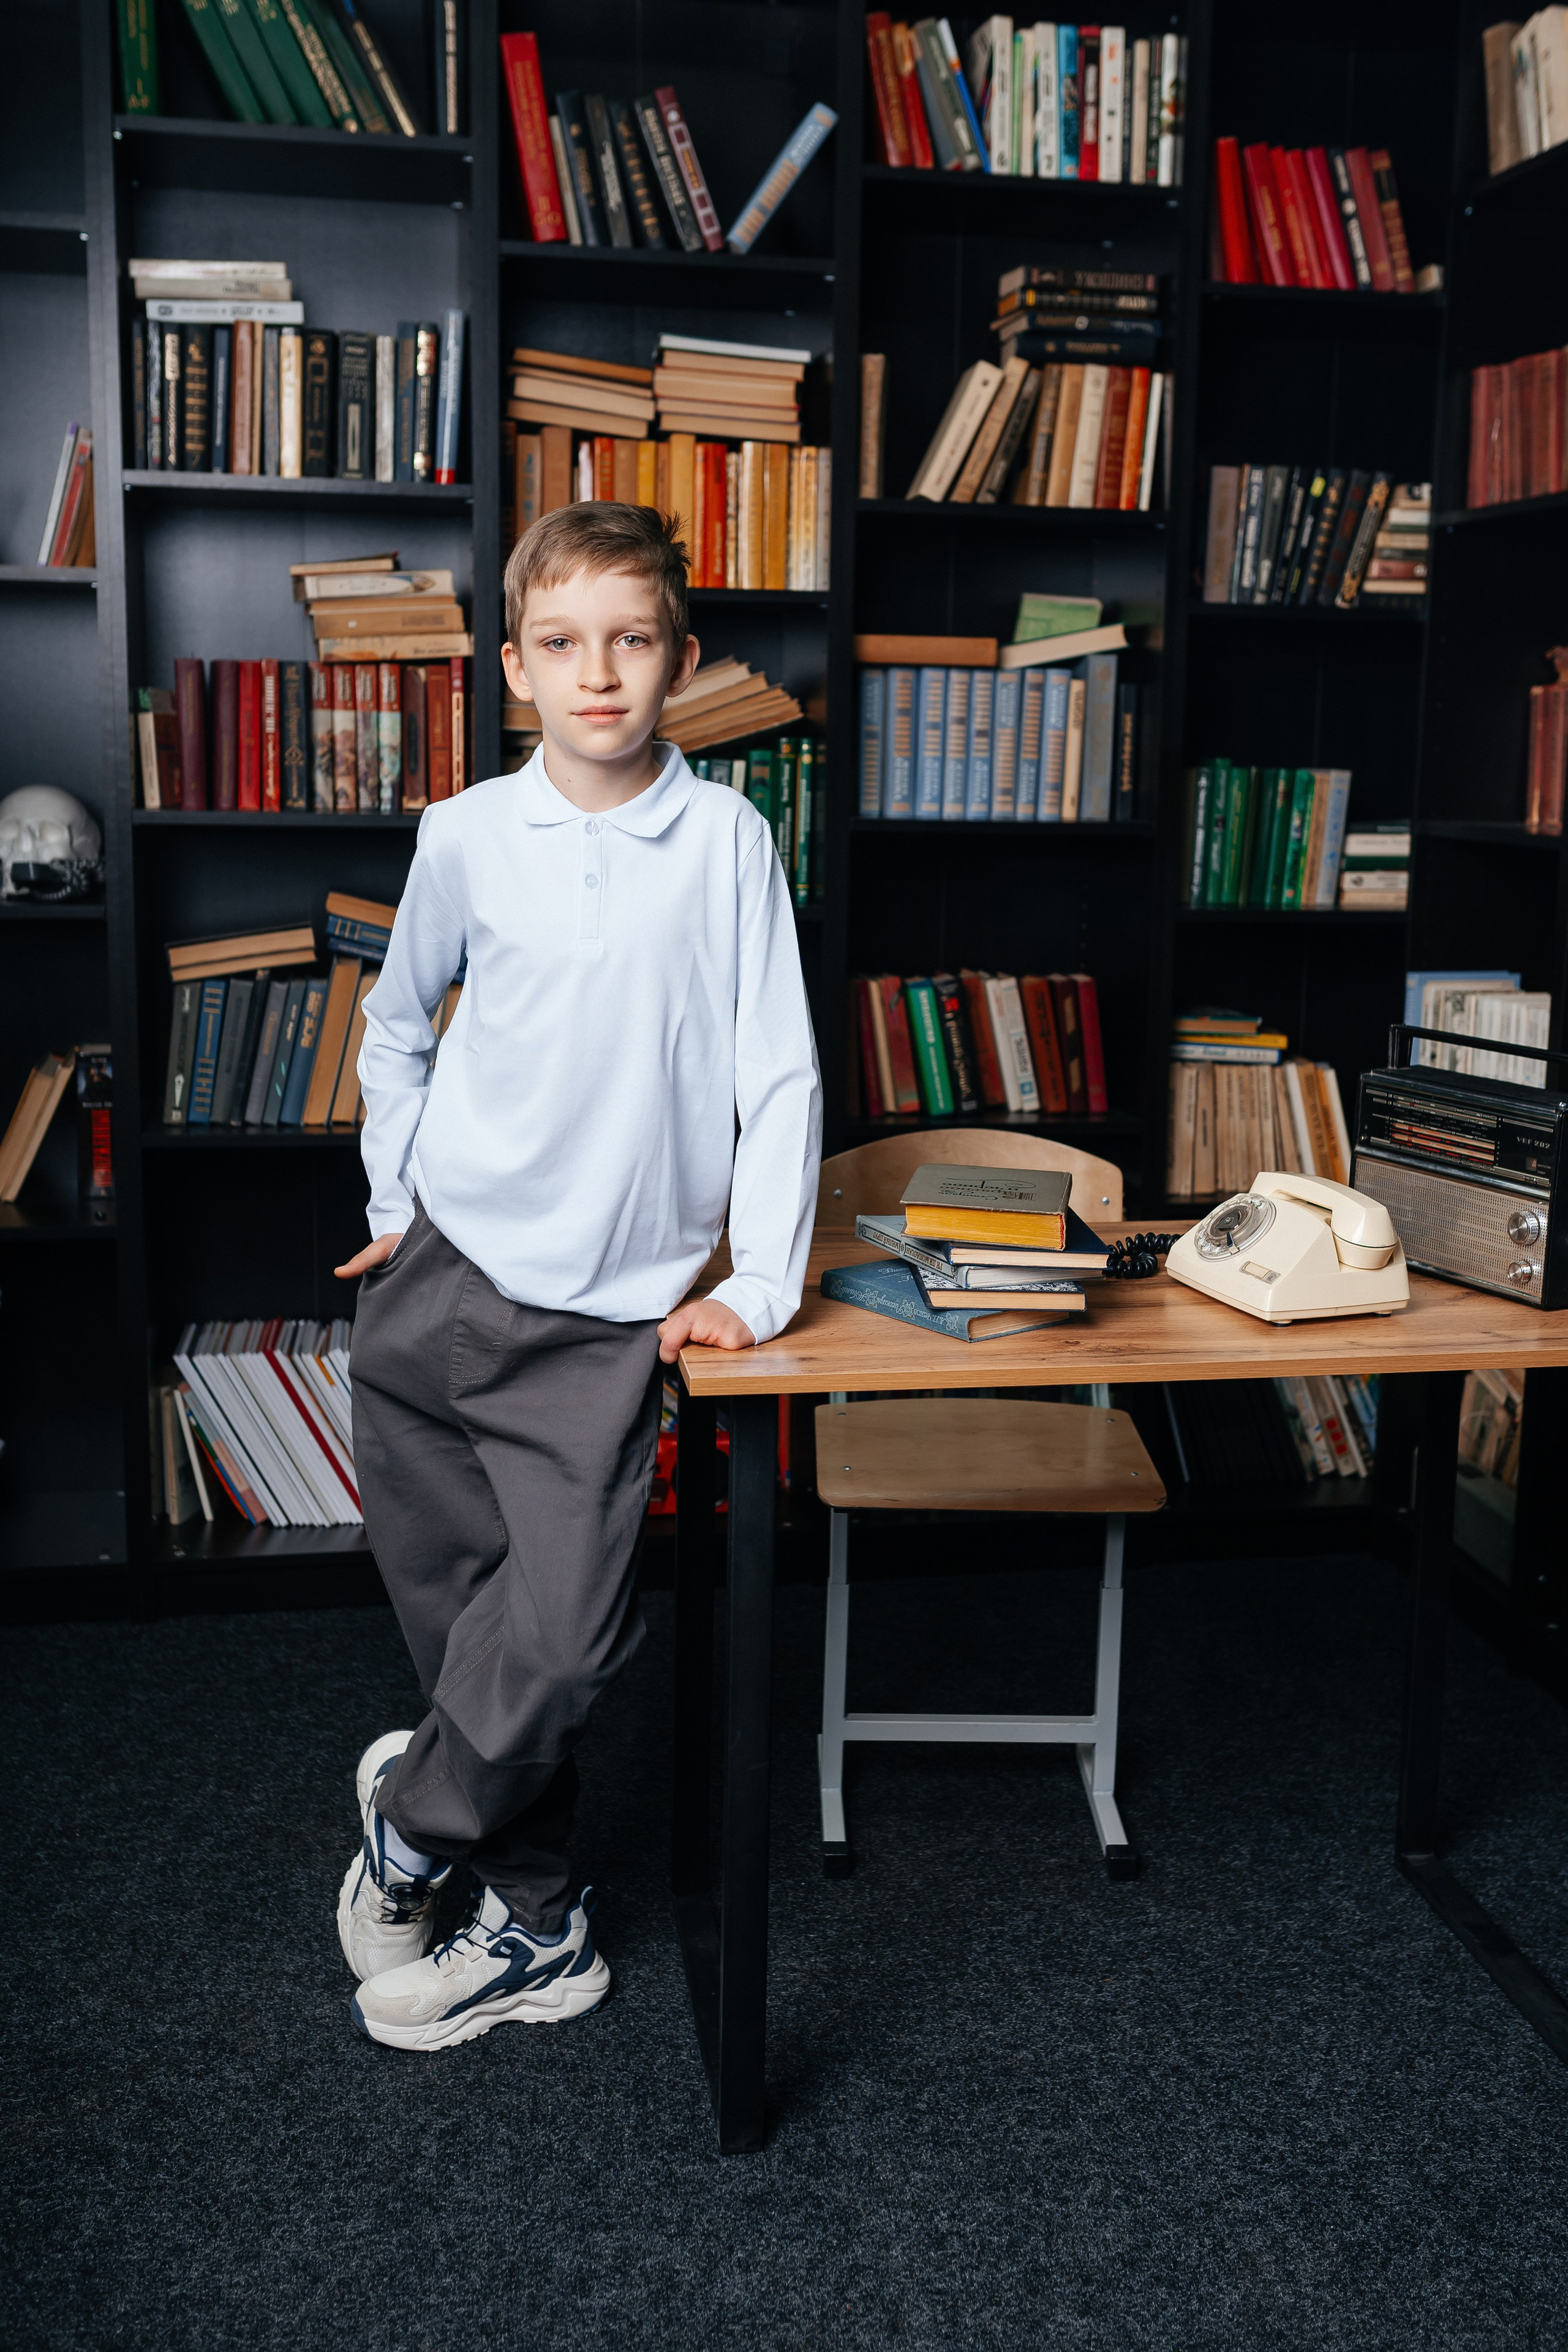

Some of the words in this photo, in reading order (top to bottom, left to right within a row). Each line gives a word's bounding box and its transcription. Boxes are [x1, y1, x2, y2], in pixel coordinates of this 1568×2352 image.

[1517, 1136, 1532, 1145] VEF
[1534, 1140, 1550, 1149] 202
[872, 1232, 884, 1242] ДРУГ
[883, 1236, 900, 1249] МИЛЫЙ
[905, 1246, 930, 1265] МОПАССАН
[876, 1294, 903, 1314] Рассказы
